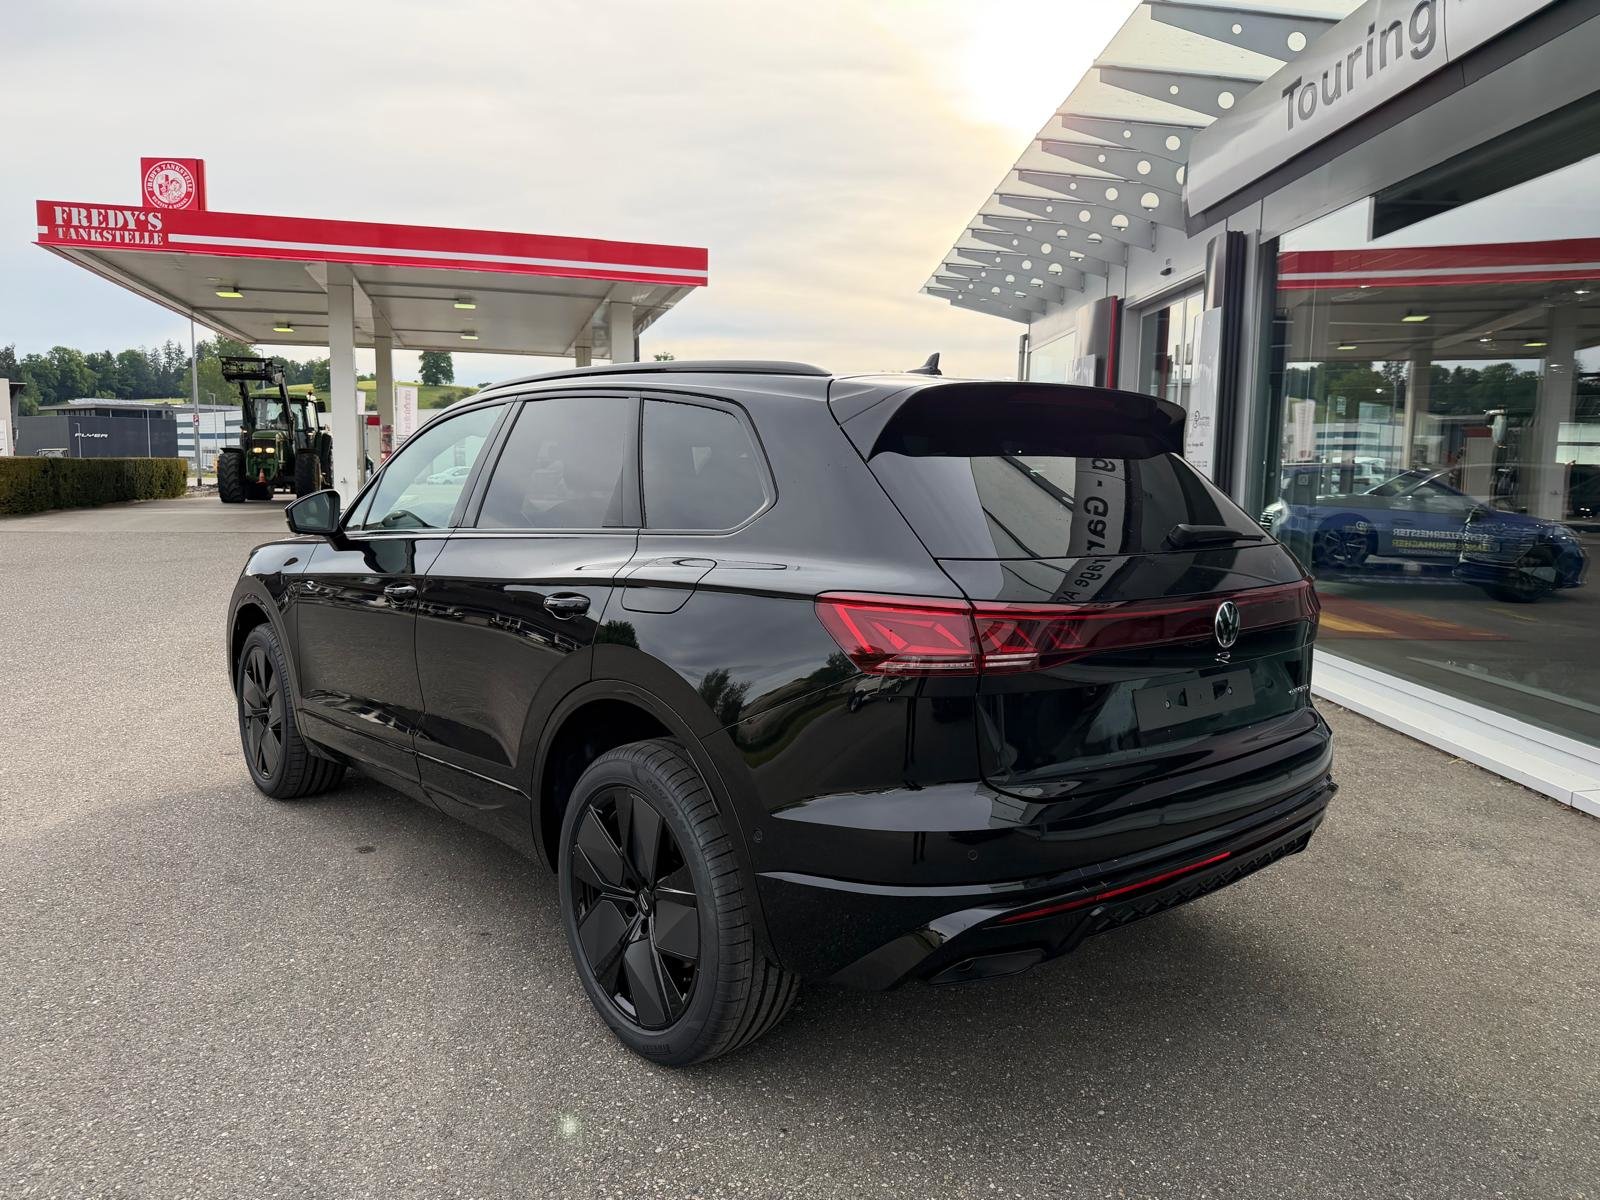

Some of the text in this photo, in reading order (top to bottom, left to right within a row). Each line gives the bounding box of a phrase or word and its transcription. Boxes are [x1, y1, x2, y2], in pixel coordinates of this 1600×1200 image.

[1281, 0, 1437, 131] Touring
[53, 206, 163, 231] FREDY'S
[55, 226, 163, 245] TANKSTELLE
